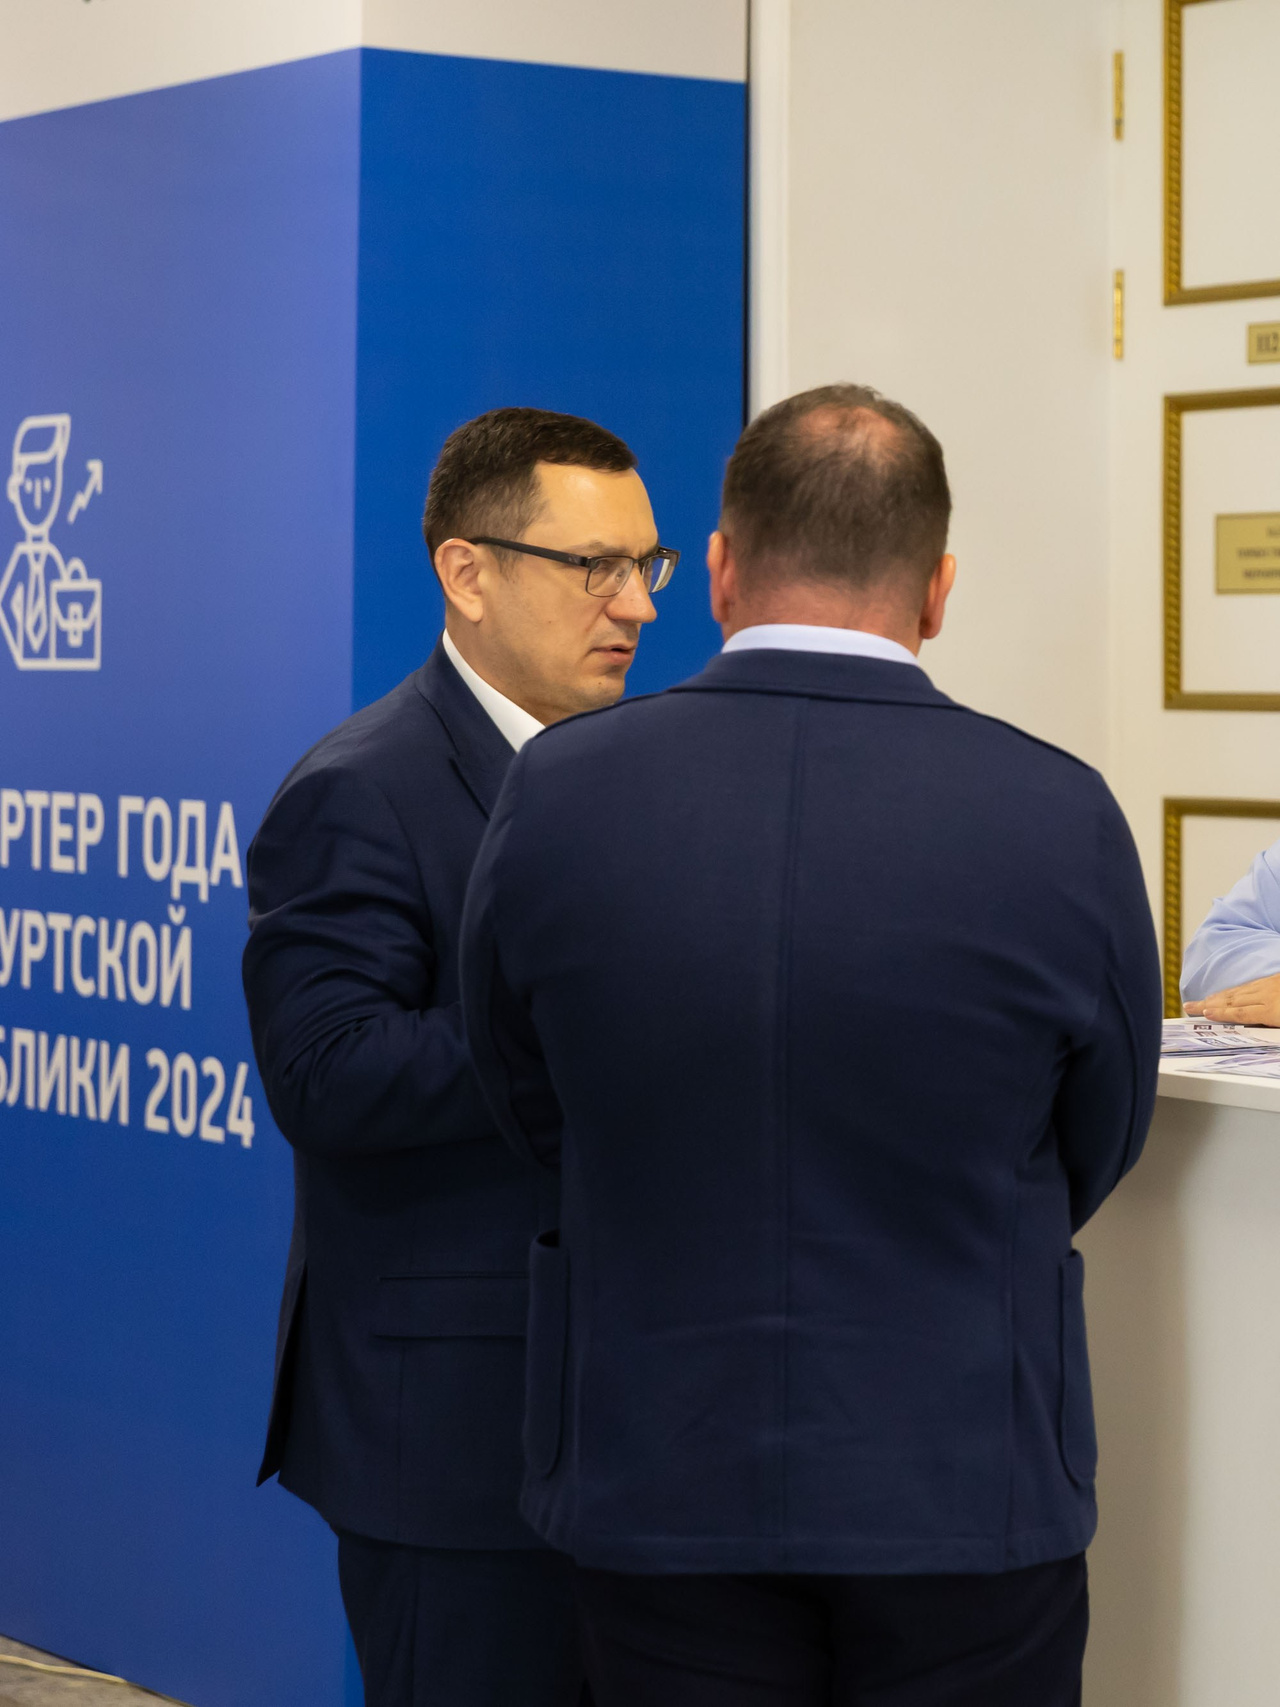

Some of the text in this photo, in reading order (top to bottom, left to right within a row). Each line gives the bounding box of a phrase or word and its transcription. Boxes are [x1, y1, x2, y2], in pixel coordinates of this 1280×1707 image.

[0, 789, 242, 902] РТЕР ГОДА
[0, 1026, 255, 1148] ЛИКИ 2024
